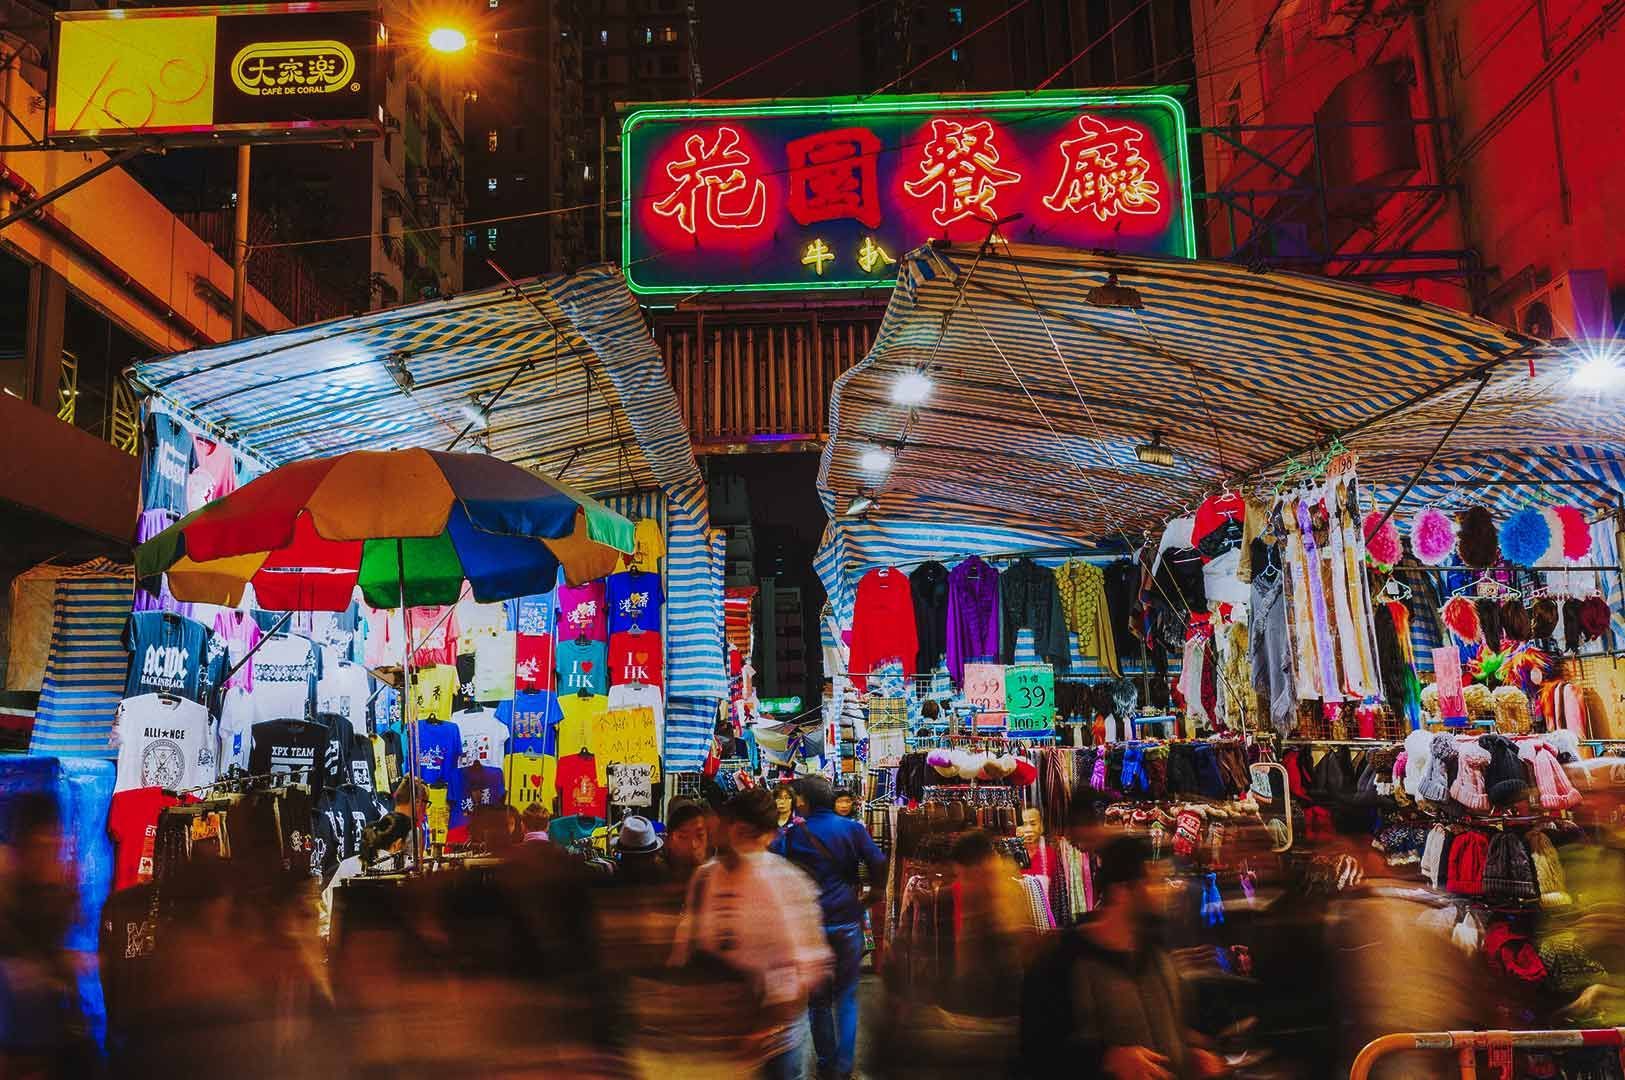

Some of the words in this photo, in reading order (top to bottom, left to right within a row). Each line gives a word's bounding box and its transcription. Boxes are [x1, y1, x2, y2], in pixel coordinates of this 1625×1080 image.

[284, 86, 296, 95] DE
[297, 85, 325, 94] CORAL
[624, 666, 649, 679] HK
[568, 674, 594, 688] HK
[271, 746, 288, 756] XPX
[291, 747, 315, 757] TEAM
[520, 789, 543, 802] HK
